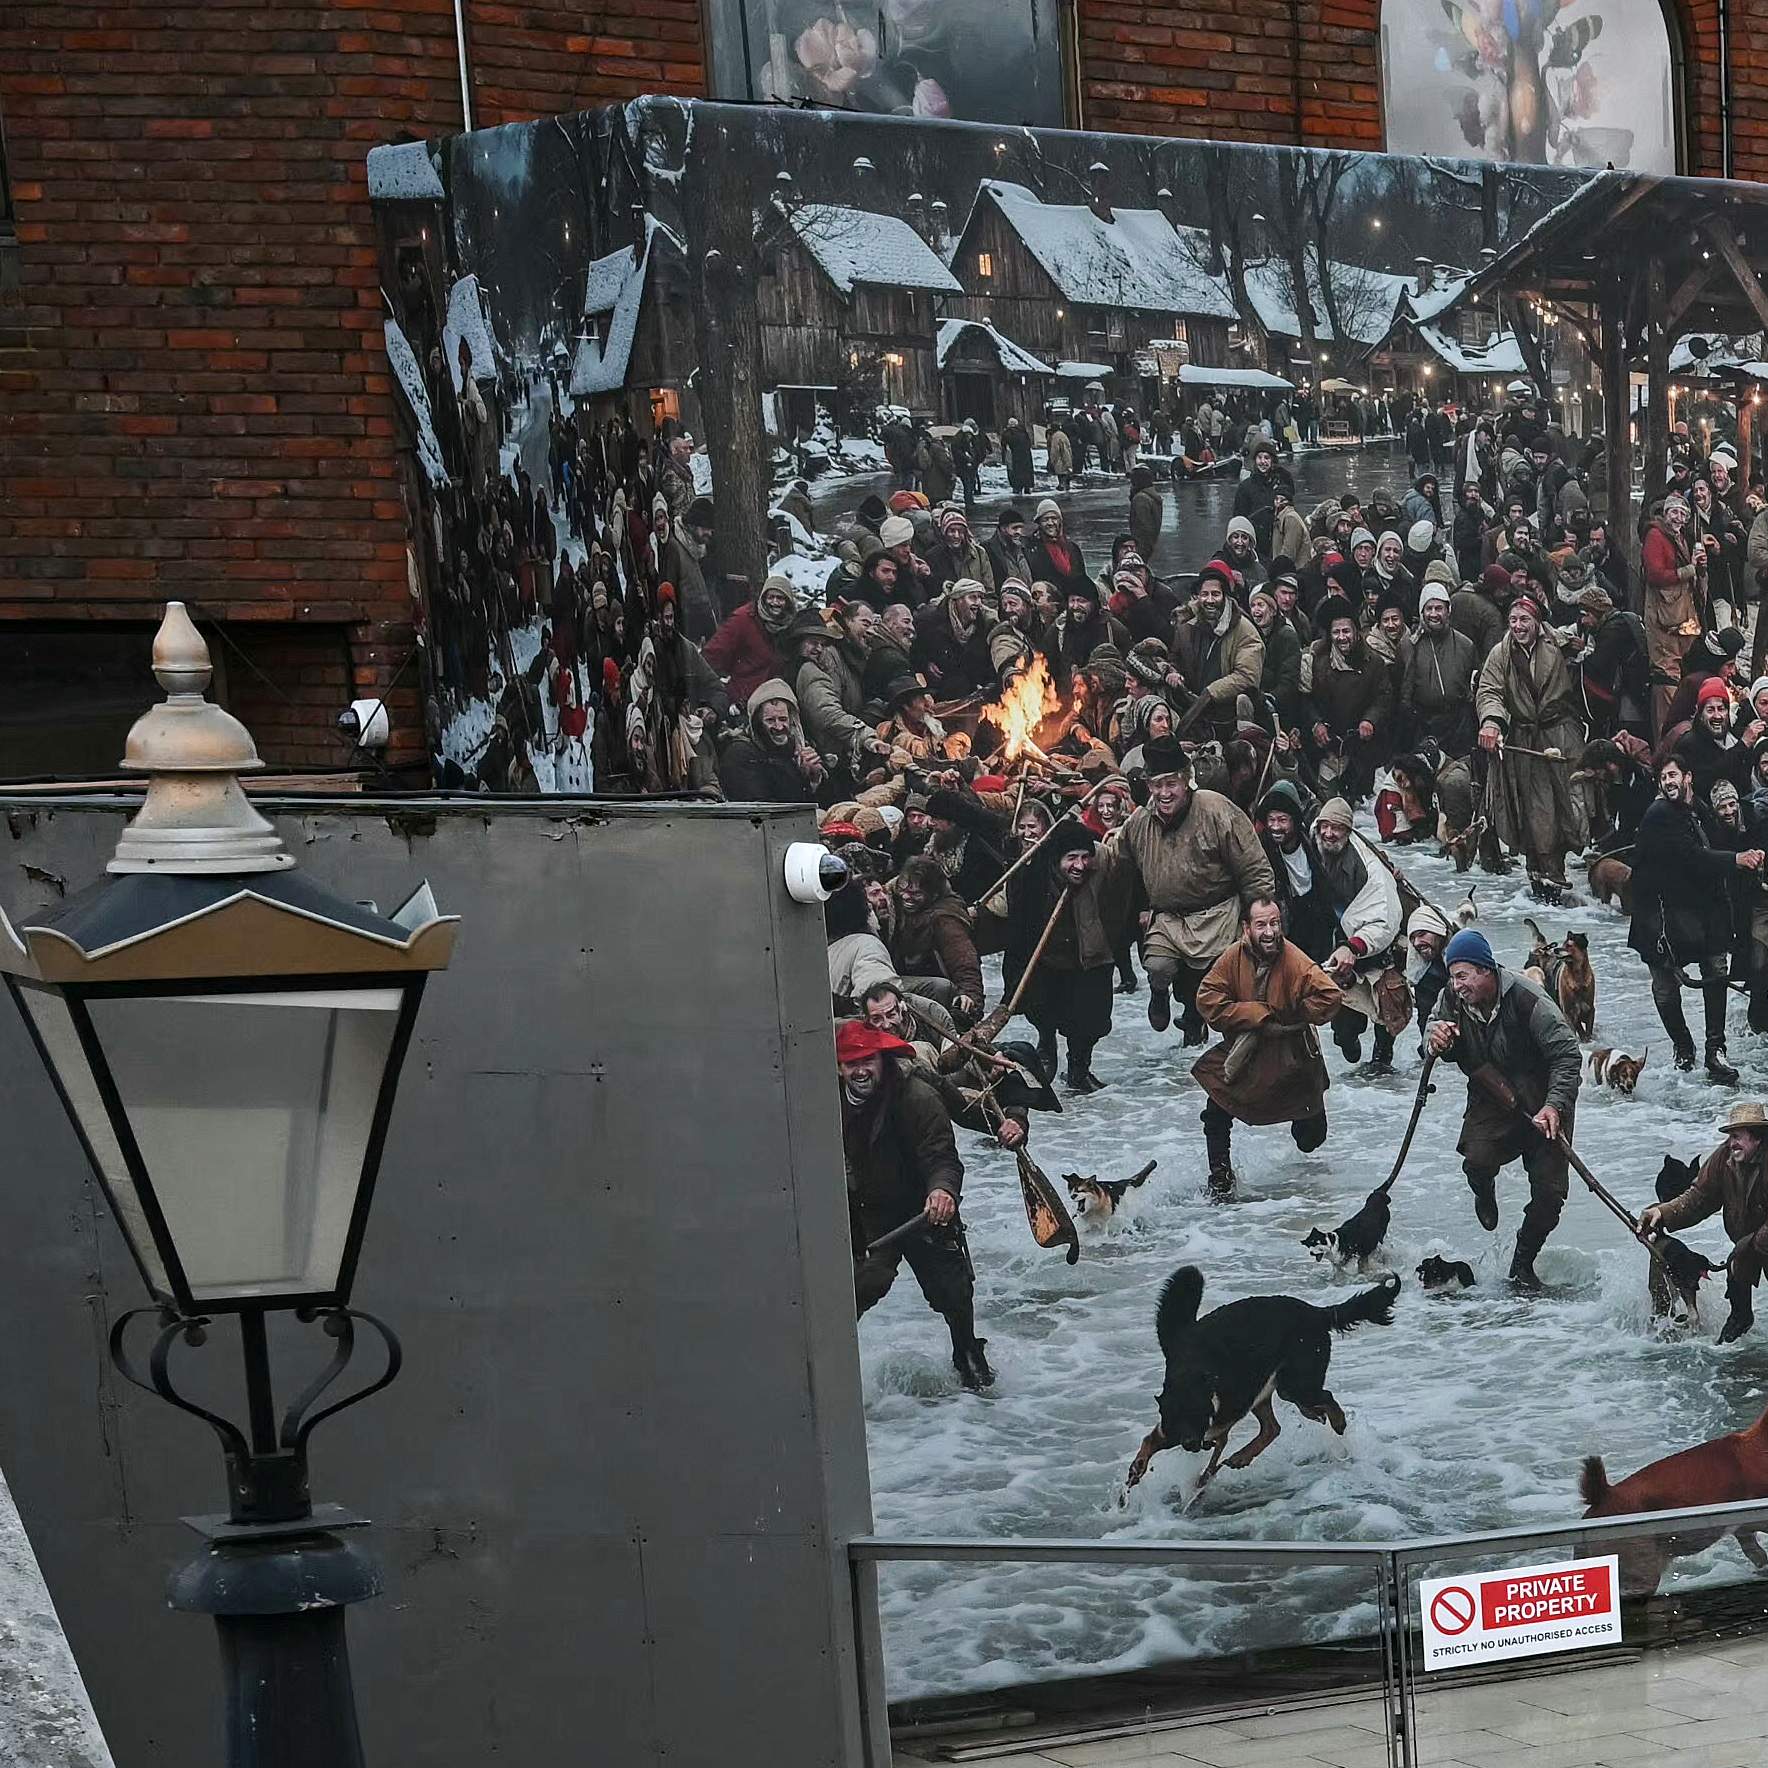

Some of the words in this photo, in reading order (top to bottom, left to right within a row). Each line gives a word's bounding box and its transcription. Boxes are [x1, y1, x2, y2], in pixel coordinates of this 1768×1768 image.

[1506, 1574, 1586, 1600] PRIVATE
[1494, 1593, 1598, 1623] PROPERTY
[1432, 1642, 1478, 1657] STRICTLY
[1480, 1640, 1495, 1650] NO
[1498, 1629, 1573, 1647] UNAUTHORISED
[1575, 1623, 1613, 1636] ACCESS
